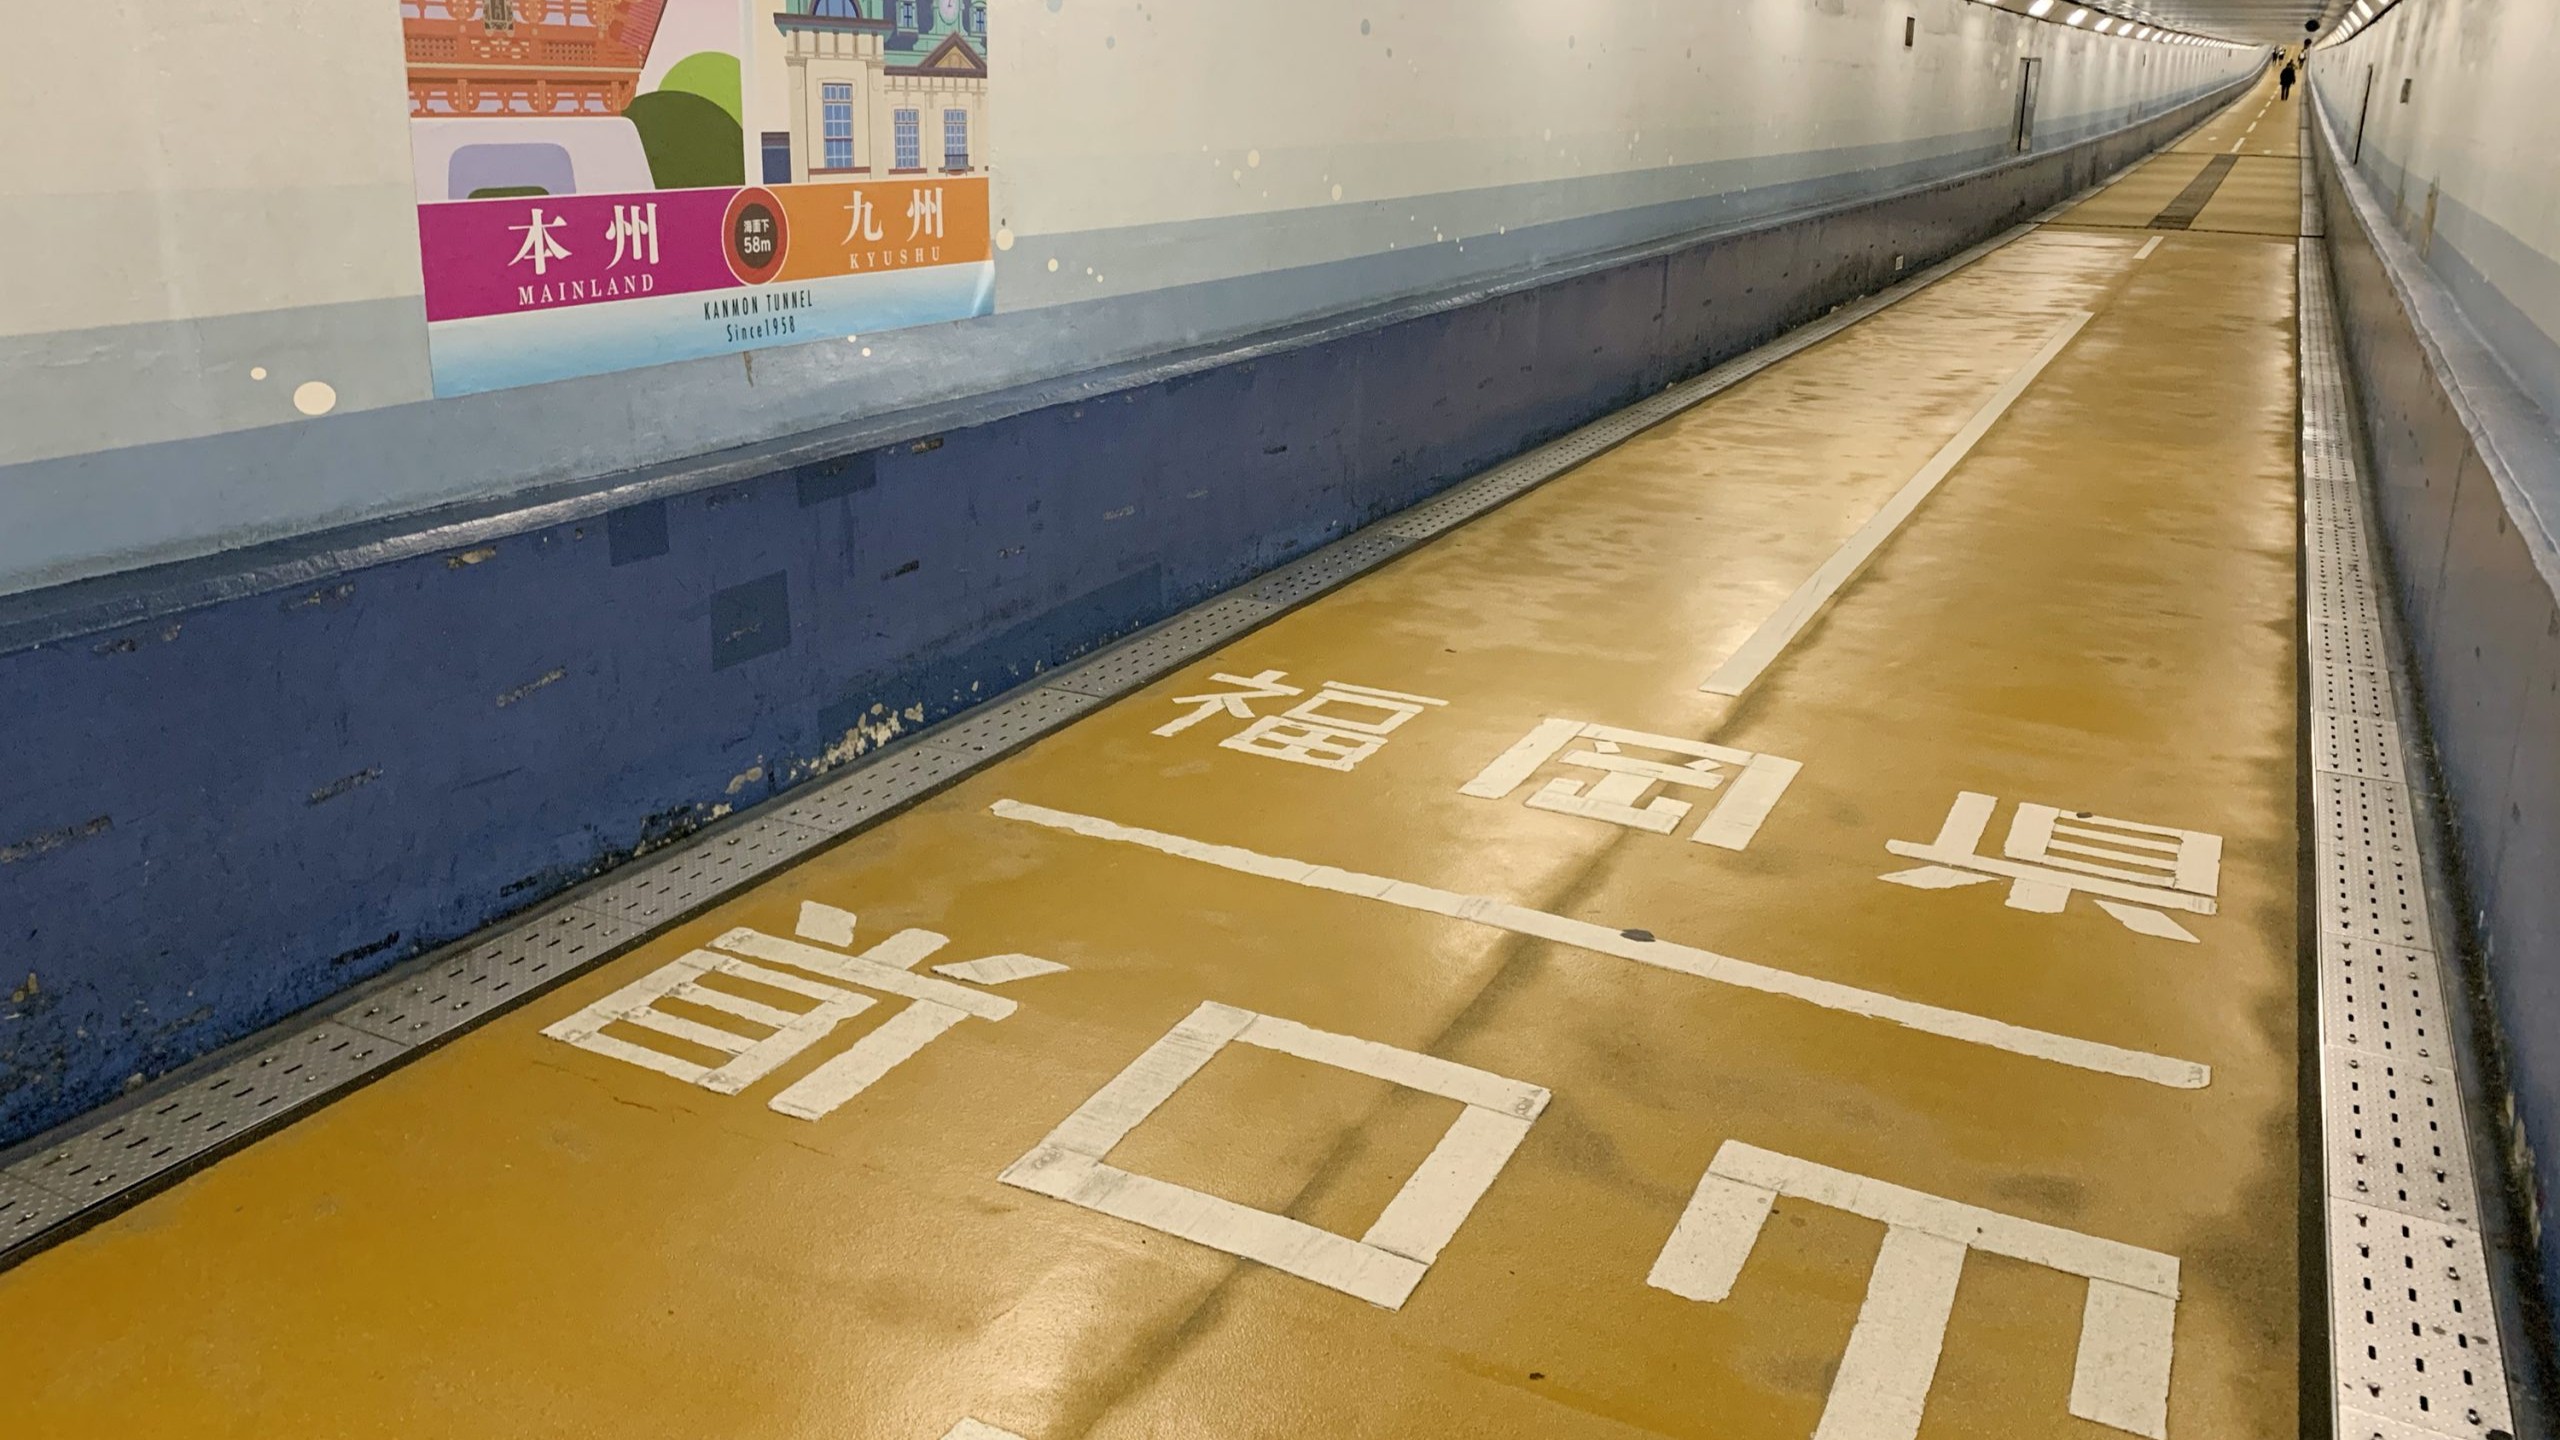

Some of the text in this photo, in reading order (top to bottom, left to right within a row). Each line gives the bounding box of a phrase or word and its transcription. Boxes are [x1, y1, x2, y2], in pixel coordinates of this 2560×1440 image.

[743, 219, 770, 234] 海面下
[841, 187, 944, 246] 九州
[507, 203, 660, 275] 本州
[743, 236, 772, 253] 58m
[849, 246, 940, 269] KYUSHU
[518, 274, 654, 306] MAINLAND
[704, 289, 813, 321] KANMON TUNNEL
[1150, 670, 2223, 943] 福岡県
